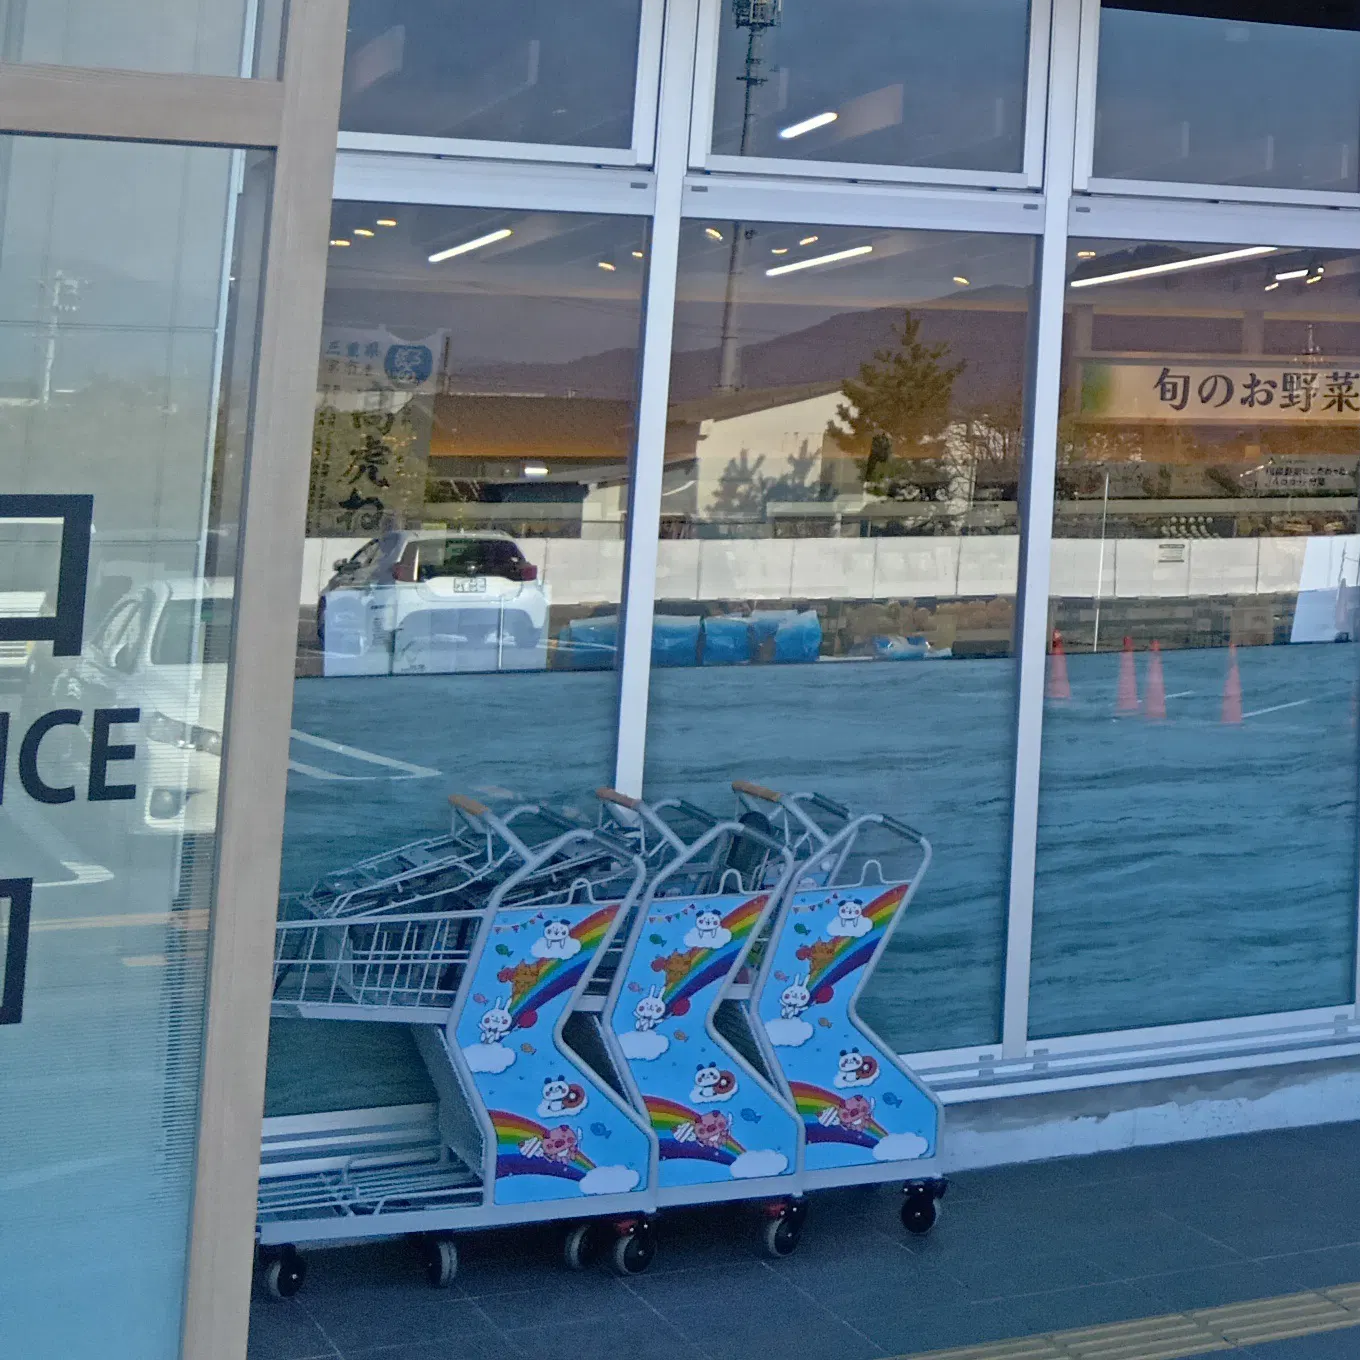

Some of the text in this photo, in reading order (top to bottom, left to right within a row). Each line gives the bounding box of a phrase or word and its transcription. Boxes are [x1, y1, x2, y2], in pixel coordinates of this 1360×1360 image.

[1154, 367, 1360, 413] 旬のお野菜
